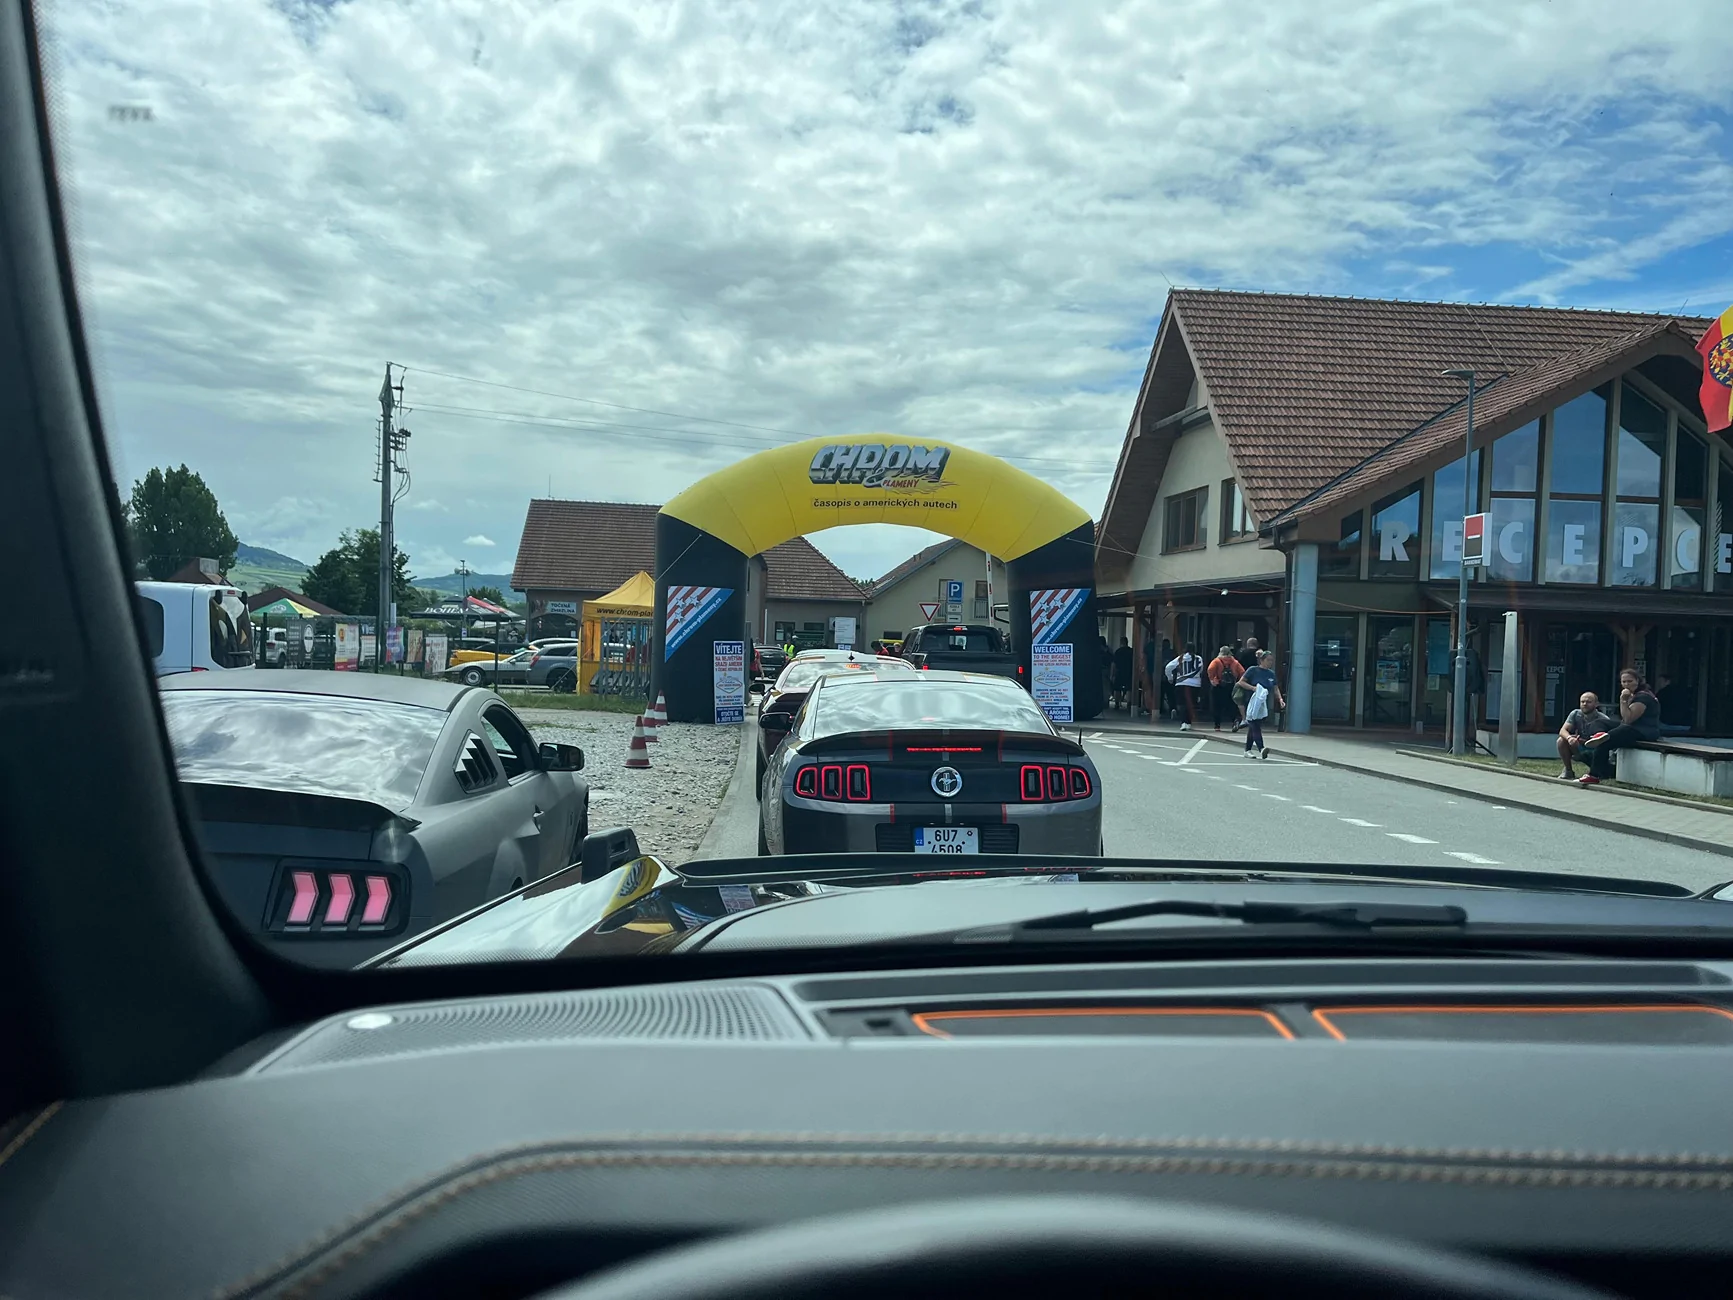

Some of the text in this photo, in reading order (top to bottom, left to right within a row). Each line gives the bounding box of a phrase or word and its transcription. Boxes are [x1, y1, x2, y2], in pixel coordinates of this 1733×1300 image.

[809, 444, 951, 484] CHROM
[882, 479, 919, 488] PLAMENY
[813, 499, 852, 509] časopis
[863, 499, 920, 509] amerických
[922, 500, 958, 509] autech
[1379, 521, 1733, 574] RECEPCE
[951, 583, 960, 597] P
[715, 643, 742, 654] VÍTEJTE
[934, 830, 958, 842] 6U7
